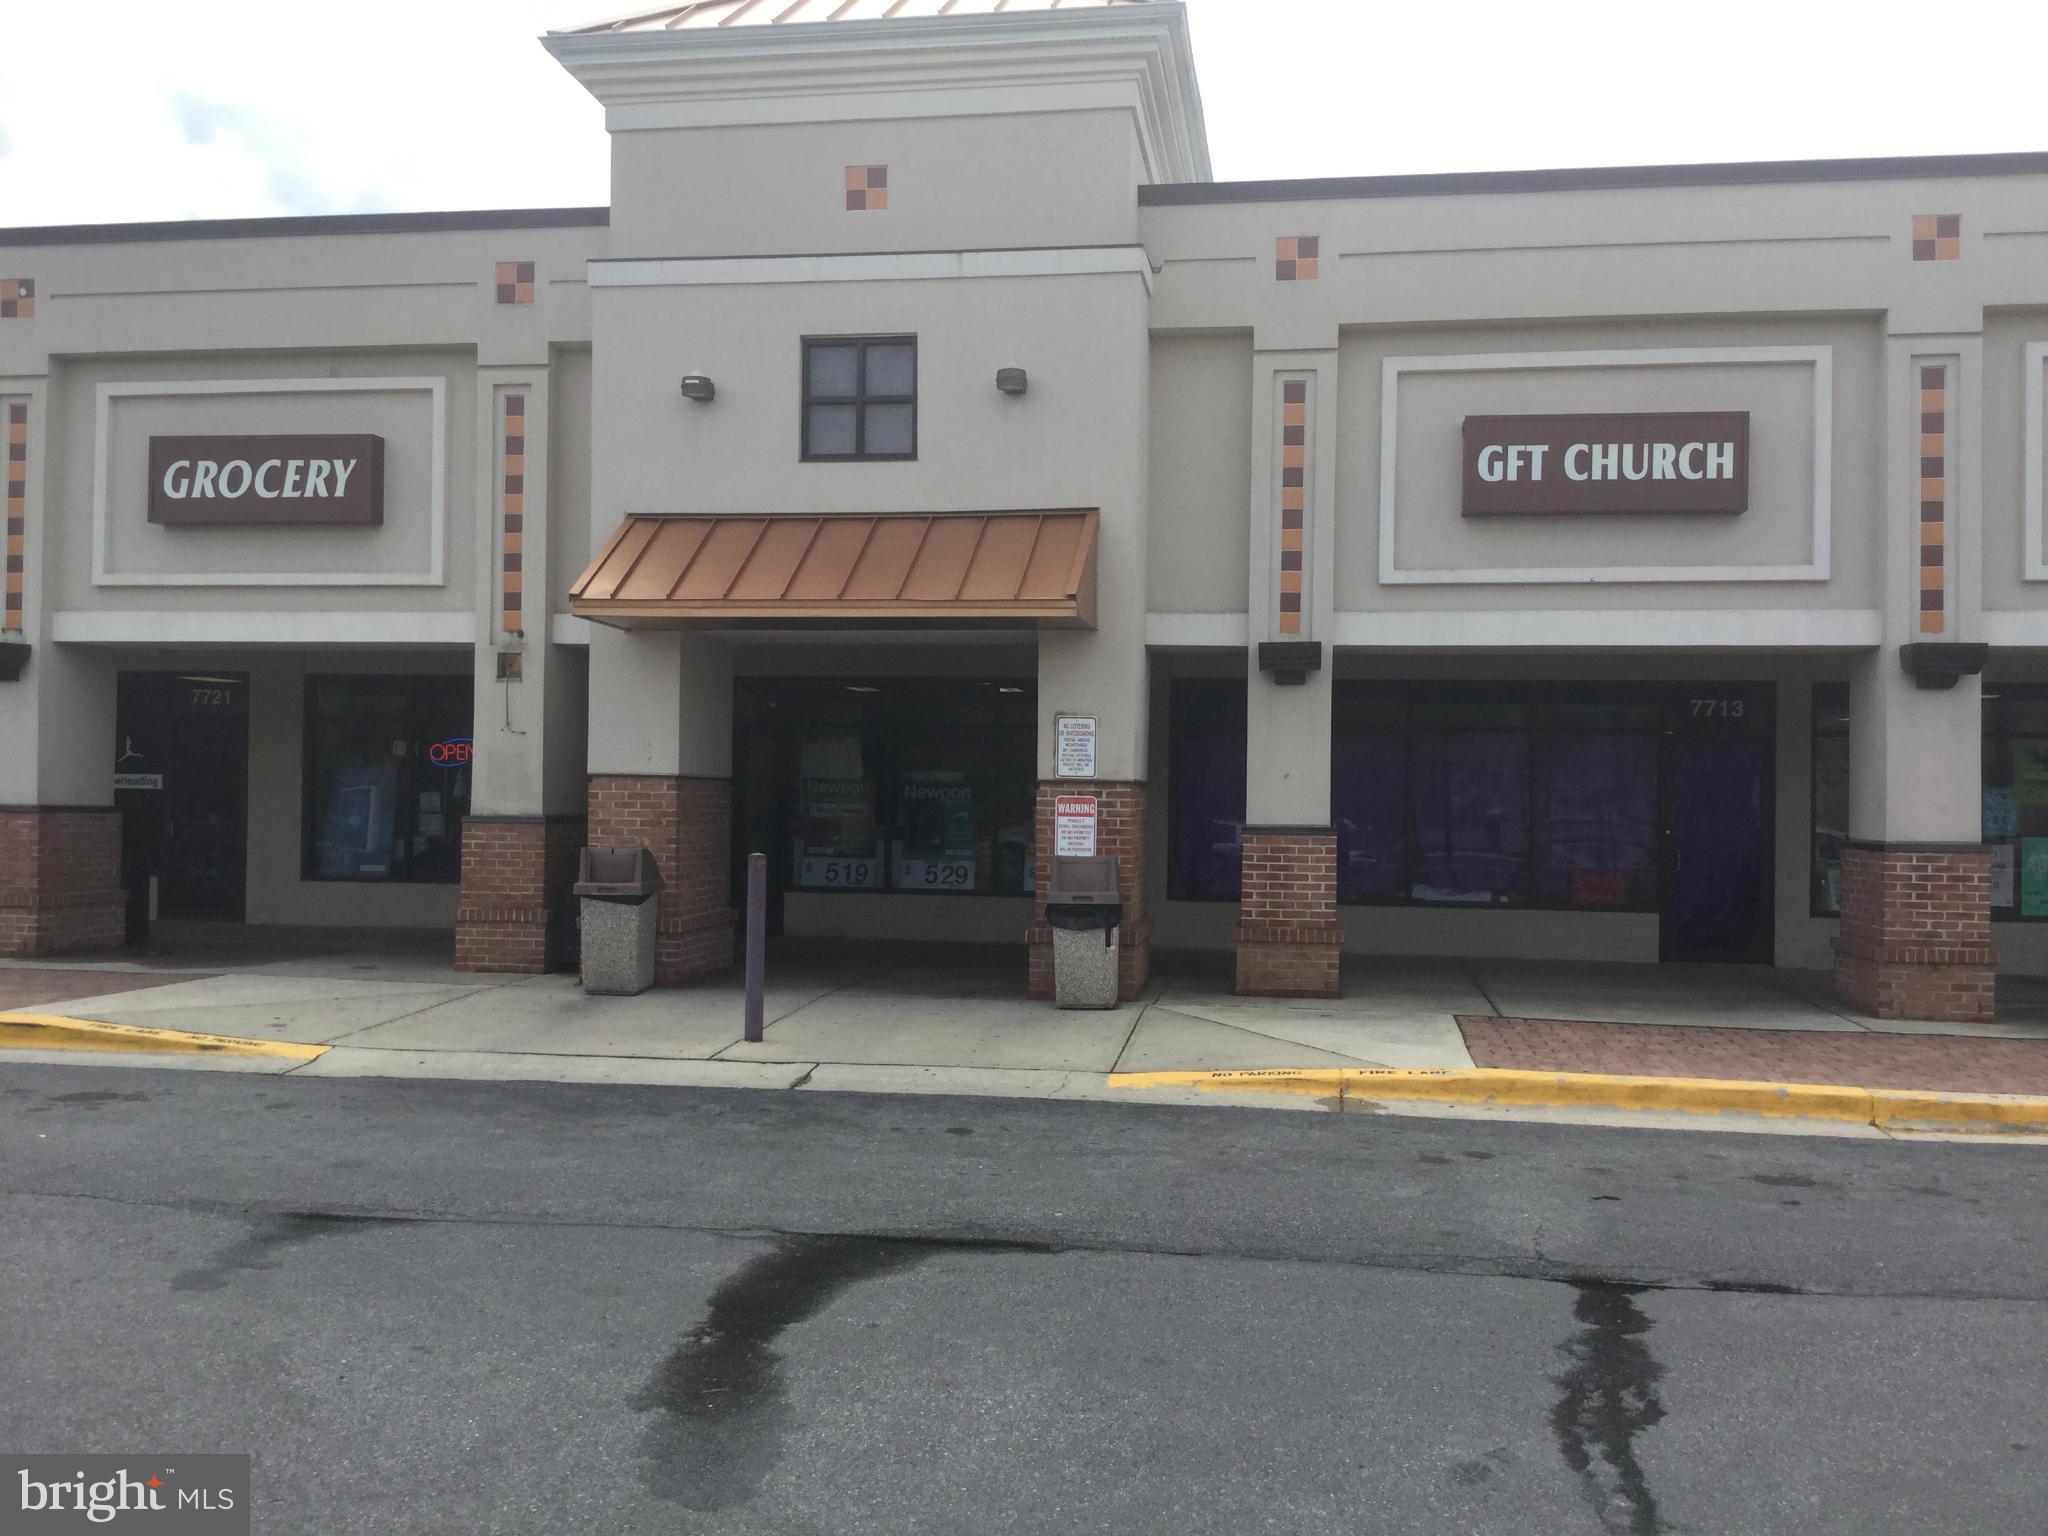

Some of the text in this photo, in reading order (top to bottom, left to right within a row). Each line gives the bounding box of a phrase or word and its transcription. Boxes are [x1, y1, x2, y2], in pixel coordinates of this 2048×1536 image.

[1477, 442, 1734, 482] GFT CHURCH
[163, 459, 357, 499] GROCERY
[192, 688, 231, 705] 7721
[1690, 699, 1744, 717] 7713
[430, 744, 473, 761] OPEN
[807, 783, 871, 796] Newport
[904, 784, 973, 800] Newport
[1058, 803, 1095, 814] WARNING
